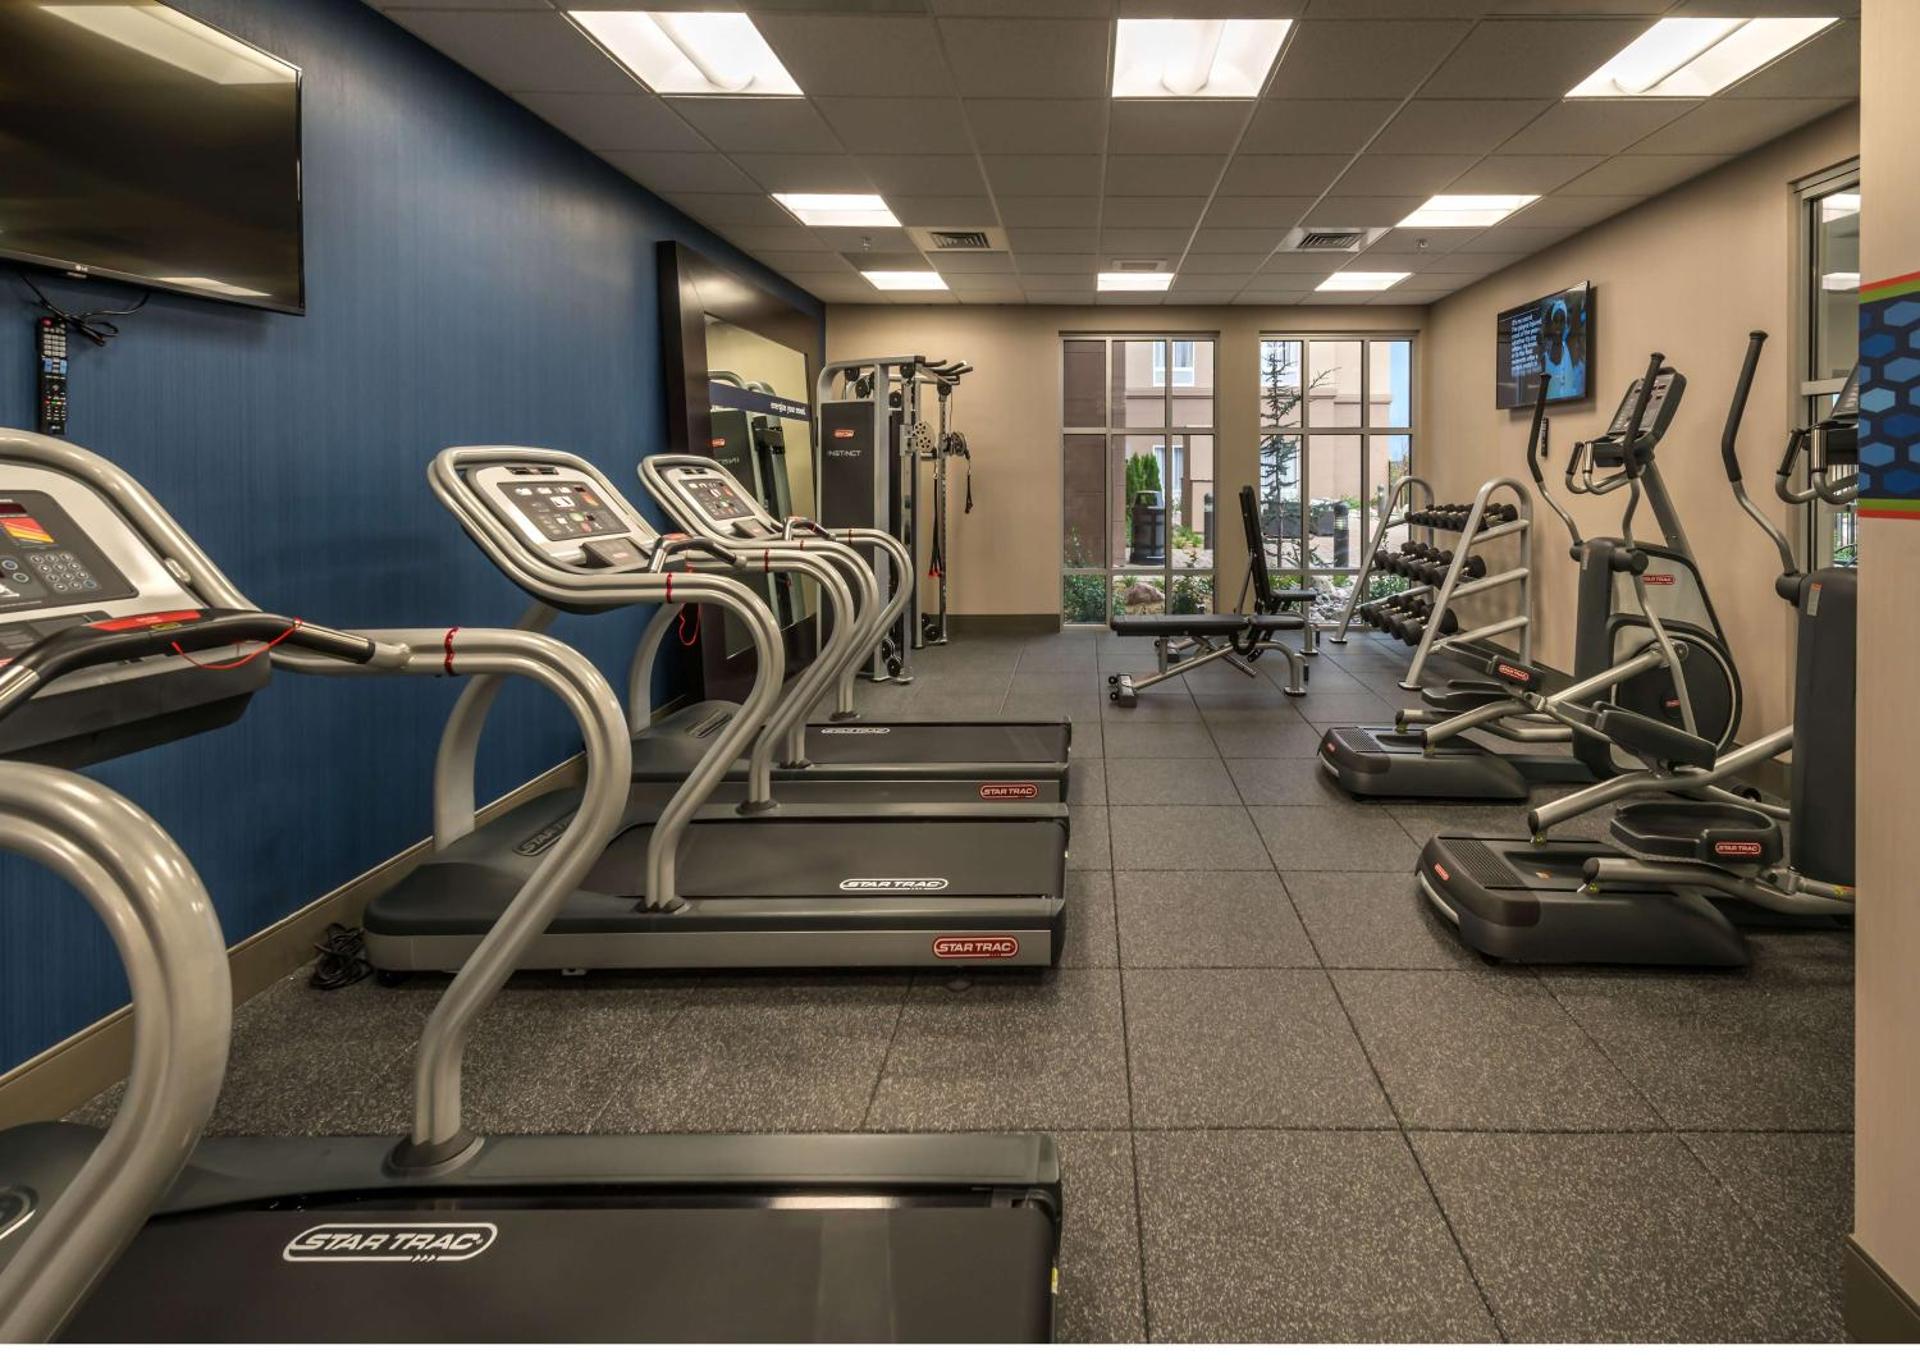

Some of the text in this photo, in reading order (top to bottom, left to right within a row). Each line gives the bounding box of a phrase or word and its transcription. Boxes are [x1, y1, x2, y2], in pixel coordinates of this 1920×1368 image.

[938, 943, 1012, 952] STAR TRAC
[303, 1233, 482, 1250] STAR TRAC
